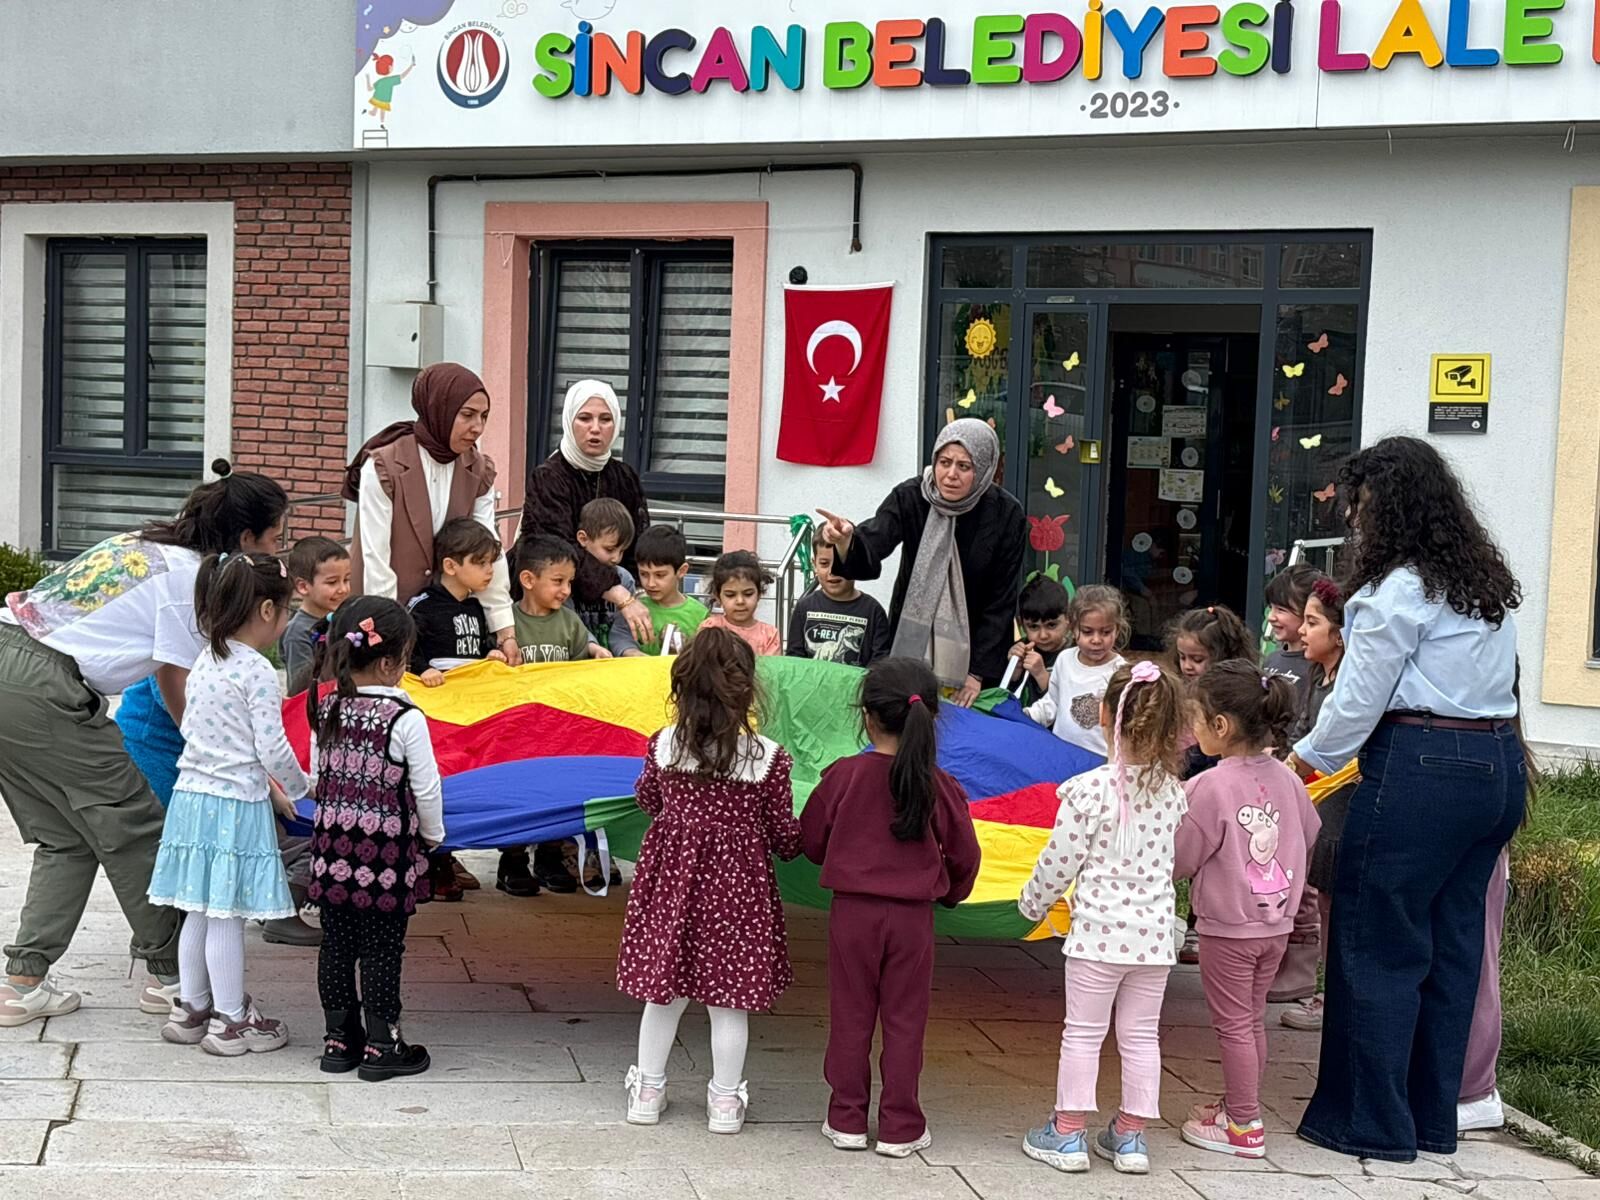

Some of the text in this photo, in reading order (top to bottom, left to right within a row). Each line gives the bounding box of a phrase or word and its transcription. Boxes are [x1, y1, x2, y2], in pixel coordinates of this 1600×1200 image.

[532, 20, 806, 99] SİNCAN
[1318, 0, 1564, 73] LALE
[813, 628, 838, 641] T-REX
